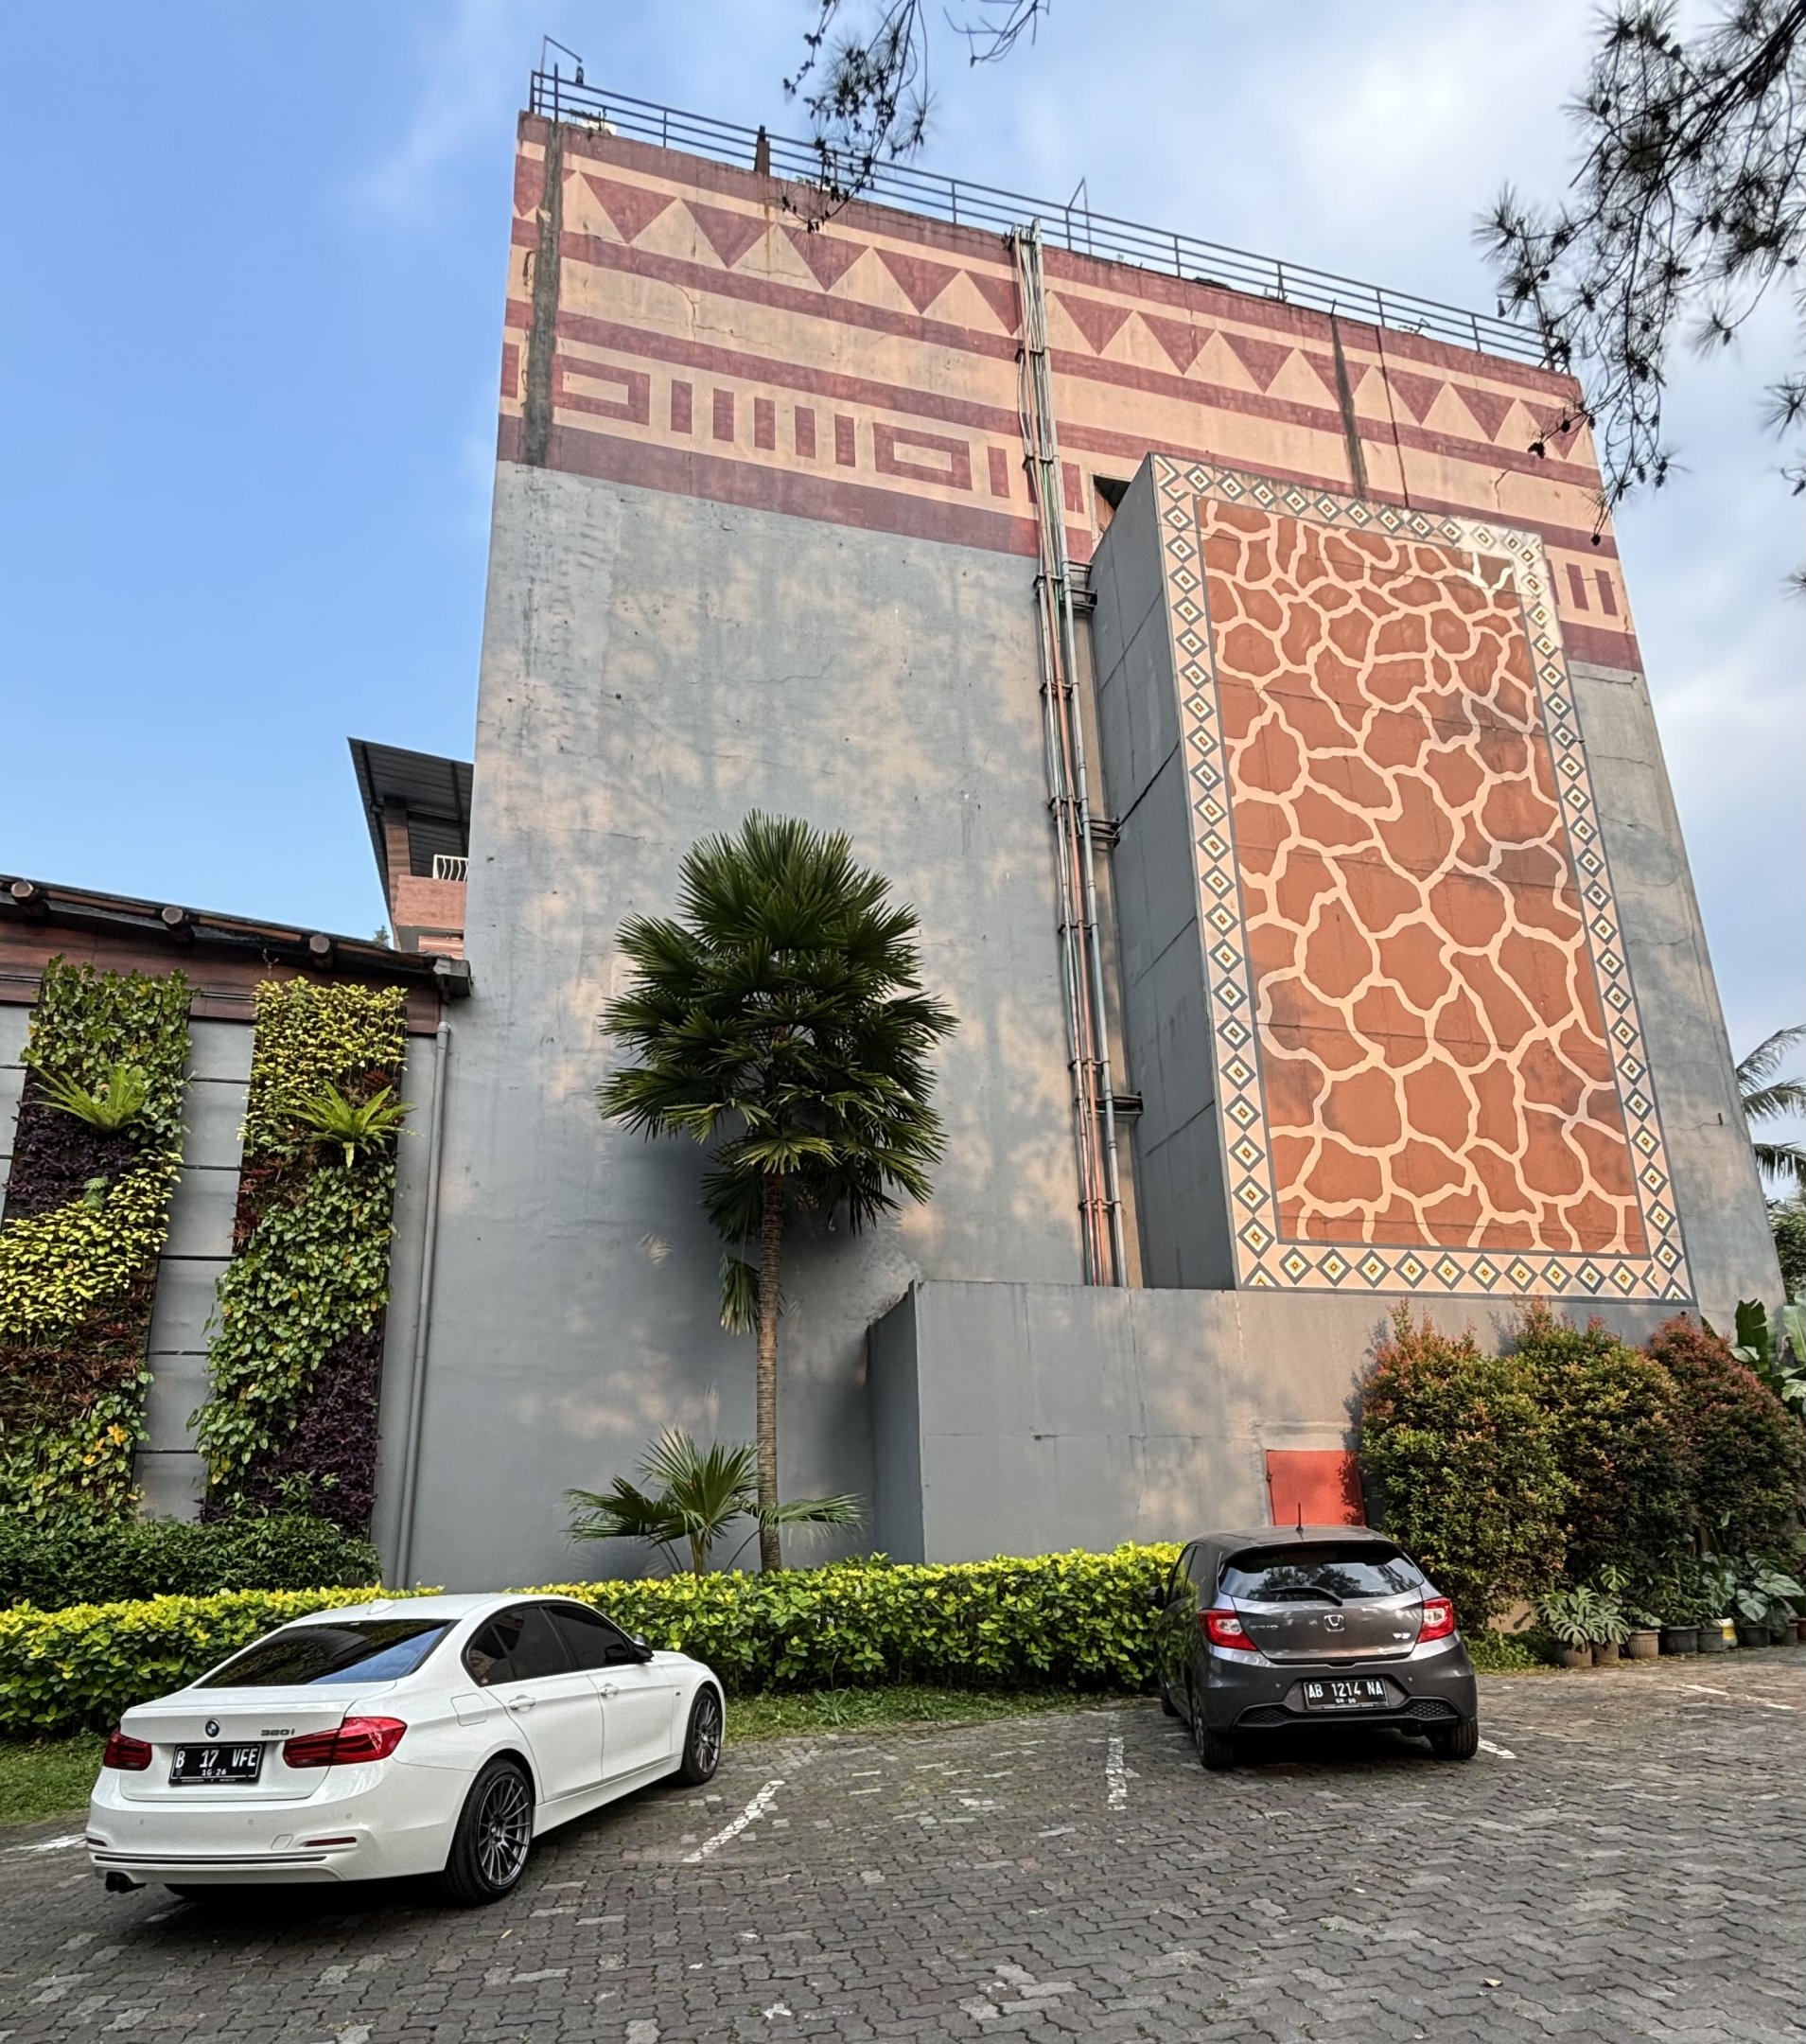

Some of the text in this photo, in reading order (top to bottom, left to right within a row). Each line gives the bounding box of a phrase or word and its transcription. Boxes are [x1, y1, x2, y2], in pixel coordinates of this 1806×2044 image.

[1308, 1681, 1383, 1699] AB 1214 NA
[175, 1748, 258, 1769] B 17 VFE
